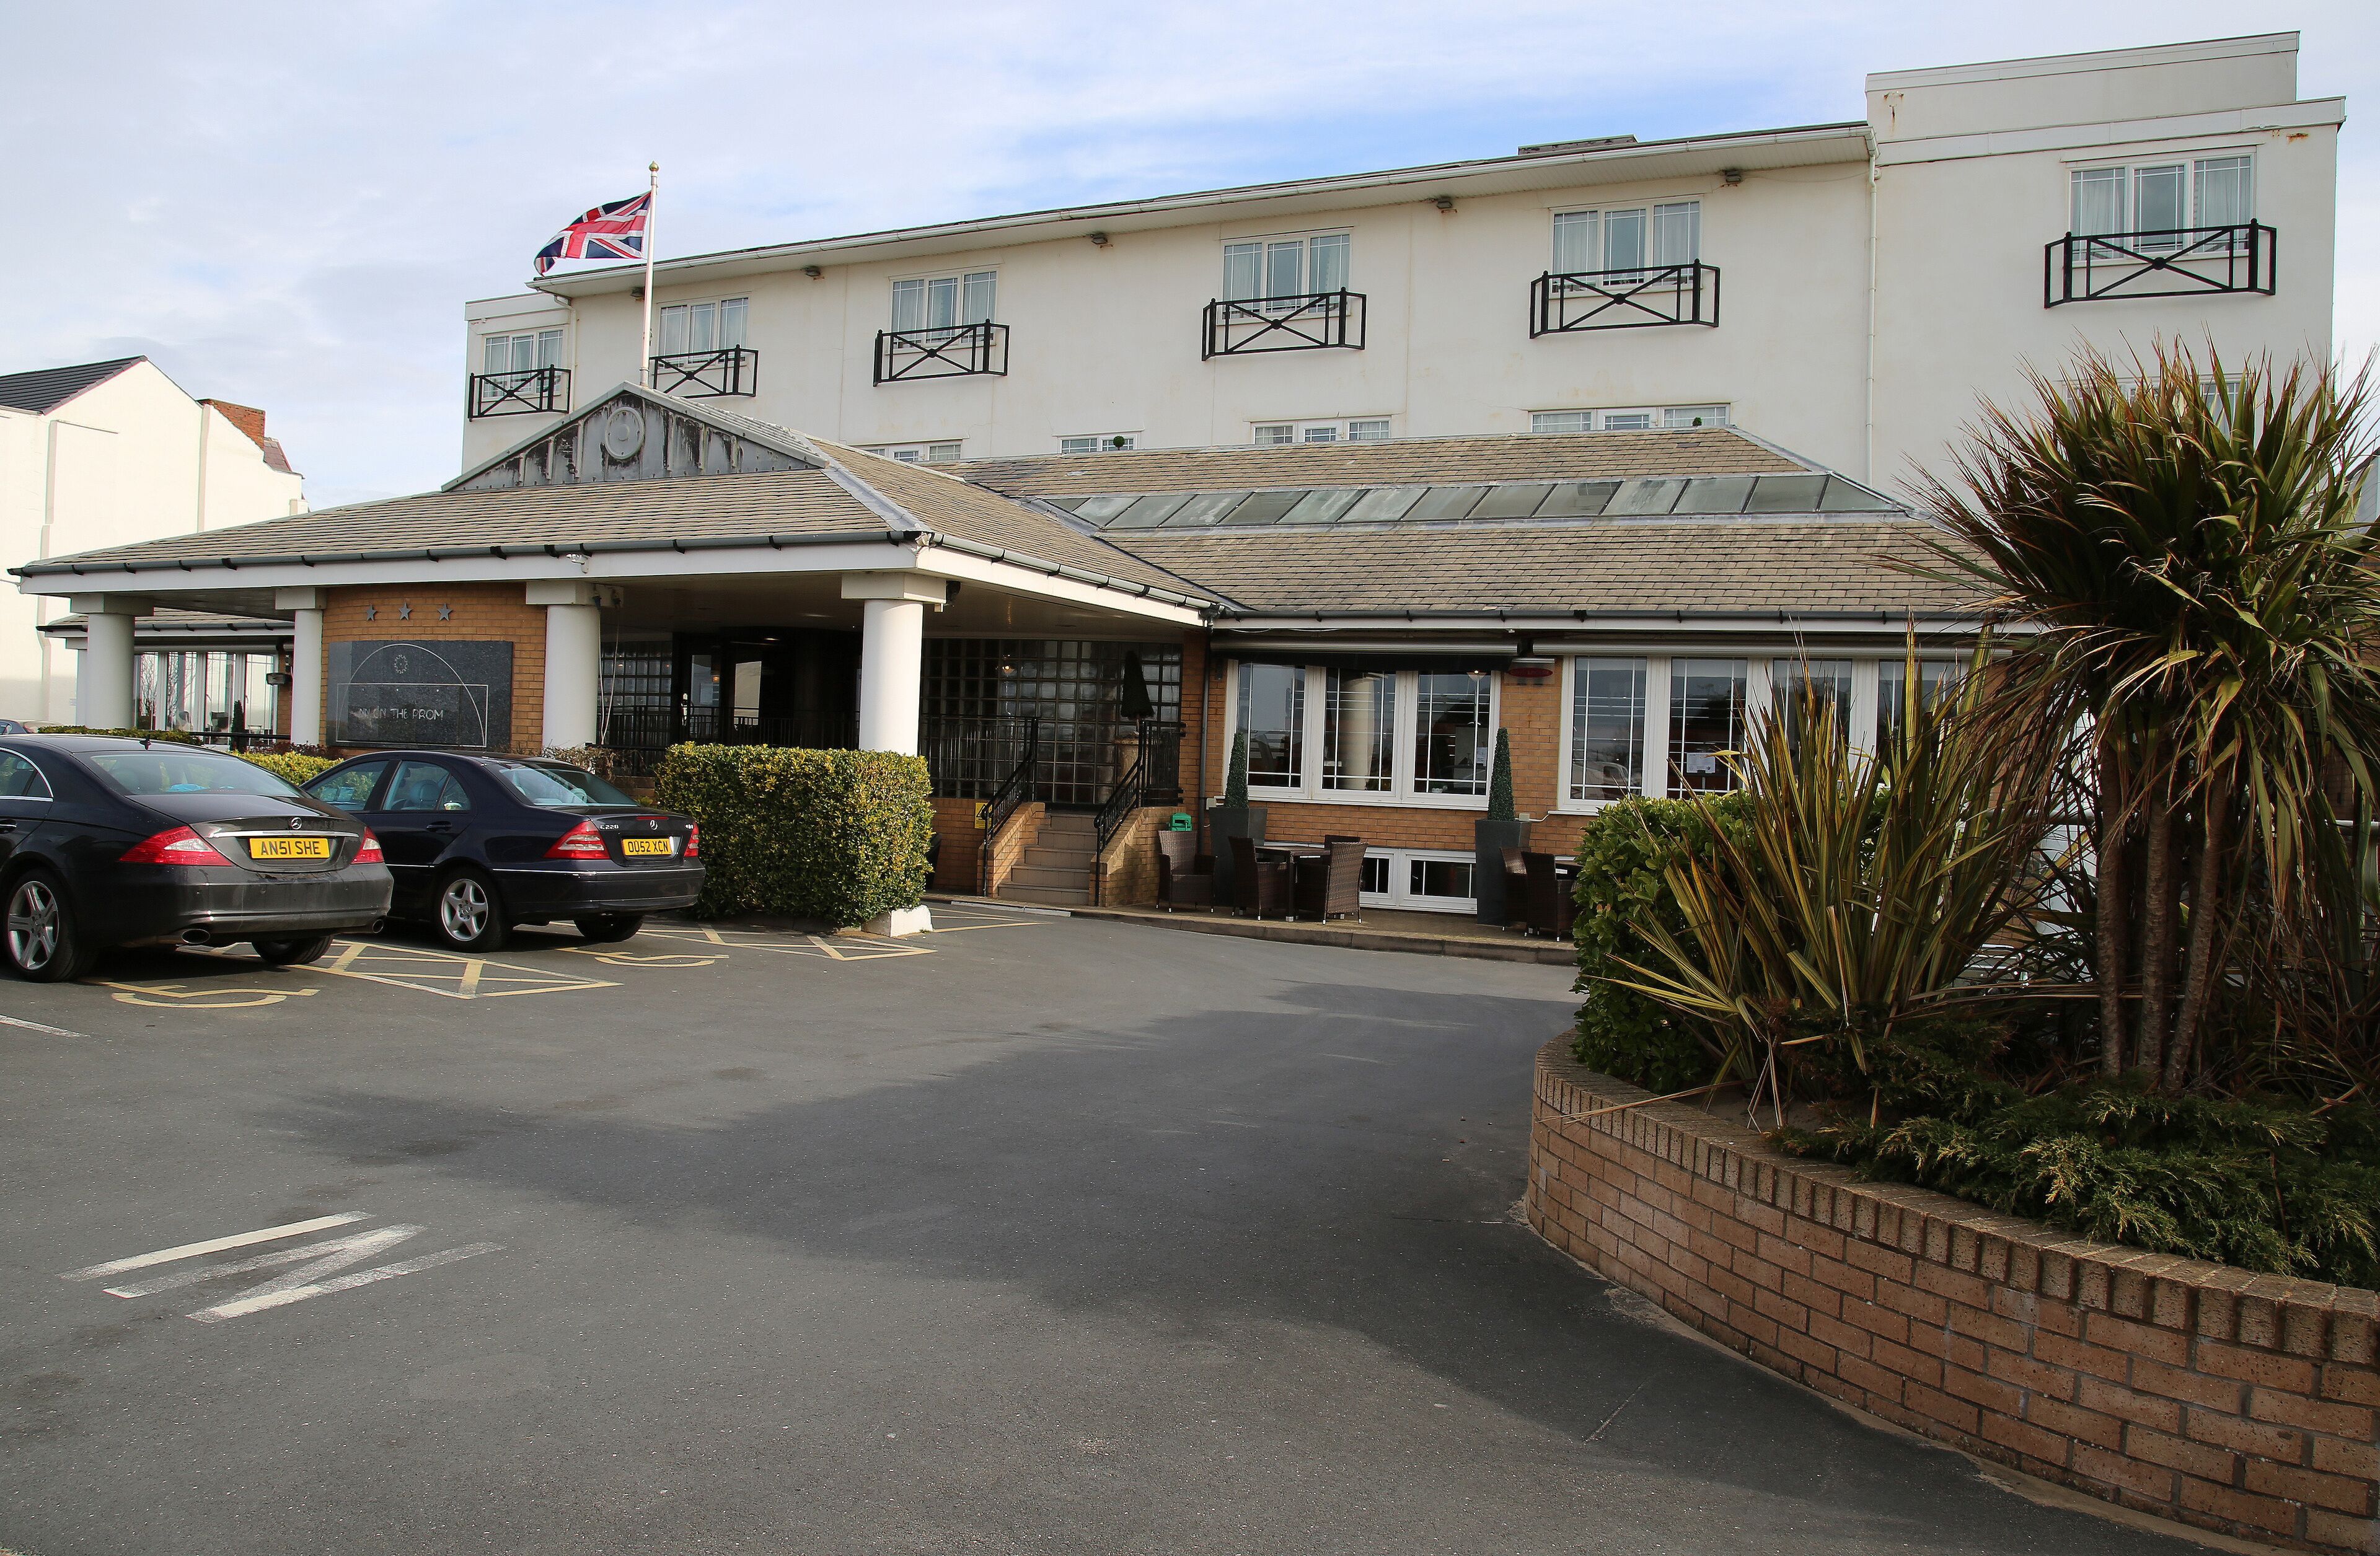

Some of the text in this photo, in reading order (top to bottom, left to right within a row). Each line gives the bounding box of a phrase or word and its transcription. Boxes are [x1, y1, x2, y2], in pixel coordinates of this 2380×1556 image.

[373, 708, 386, 719] ON
[390, 708, 408, 719] THE
[412, 708, 444, 720] PROM
[261, 841, 321, 855] AN51 SHE
[628, 840, 669, 852] OU52 XCN
